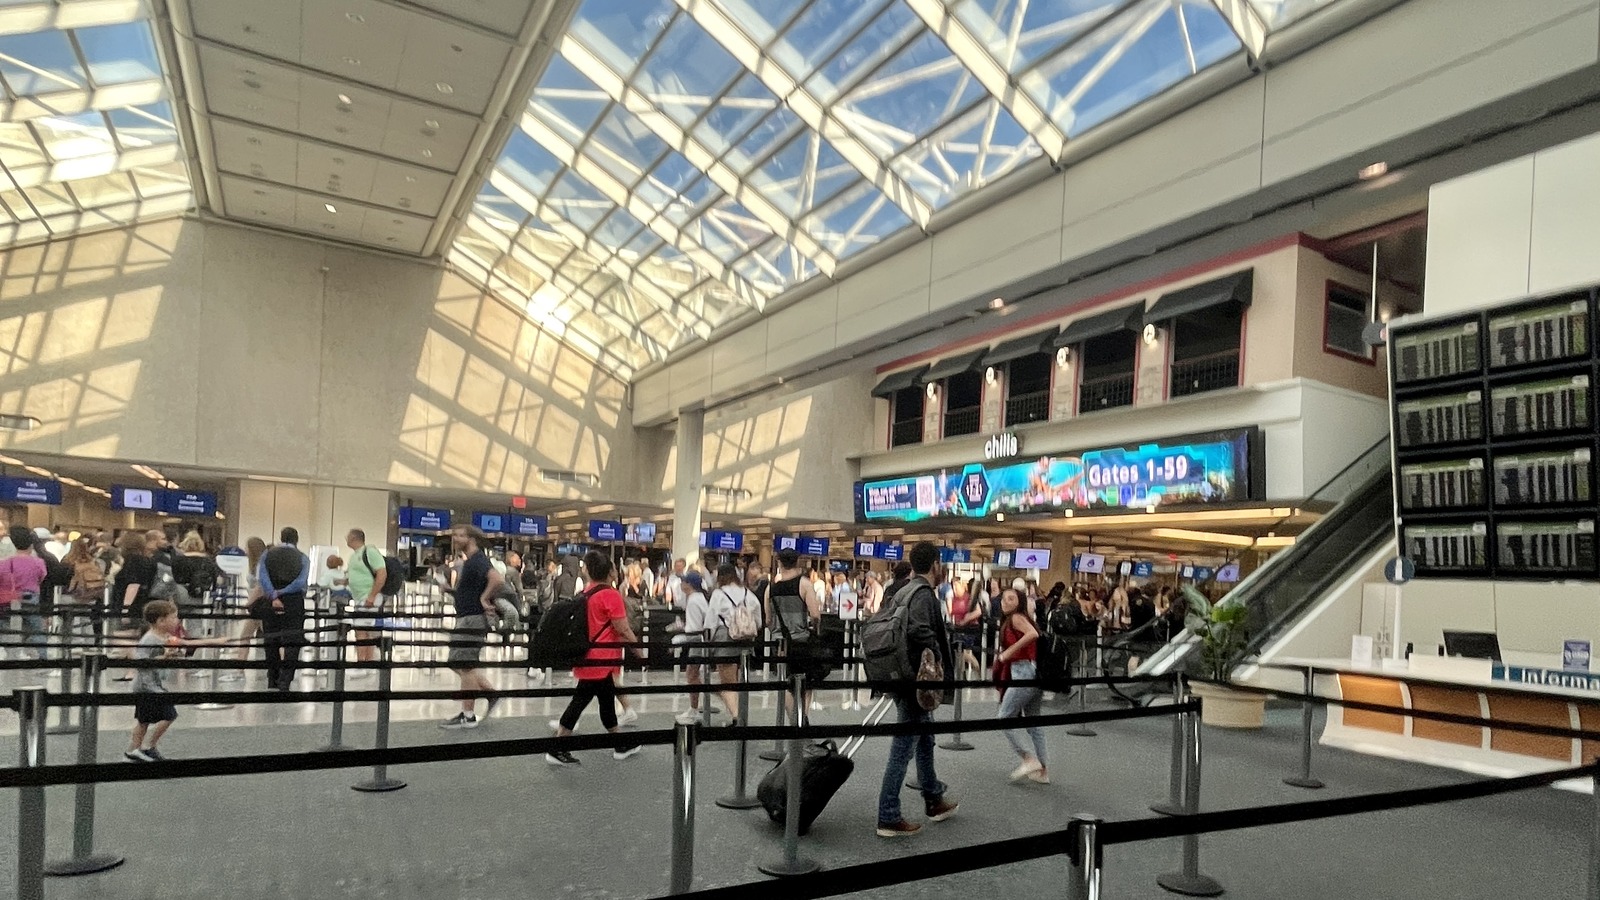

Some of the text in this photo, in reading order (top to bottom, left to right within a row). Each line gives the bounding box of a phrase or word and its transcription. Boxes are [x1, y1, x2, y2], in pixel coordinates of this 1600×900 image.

[1088, 455, 1188, 487] Gates 1-59
[487, 518, 496, 528] 6
[862, 545, 873, 553] 10
